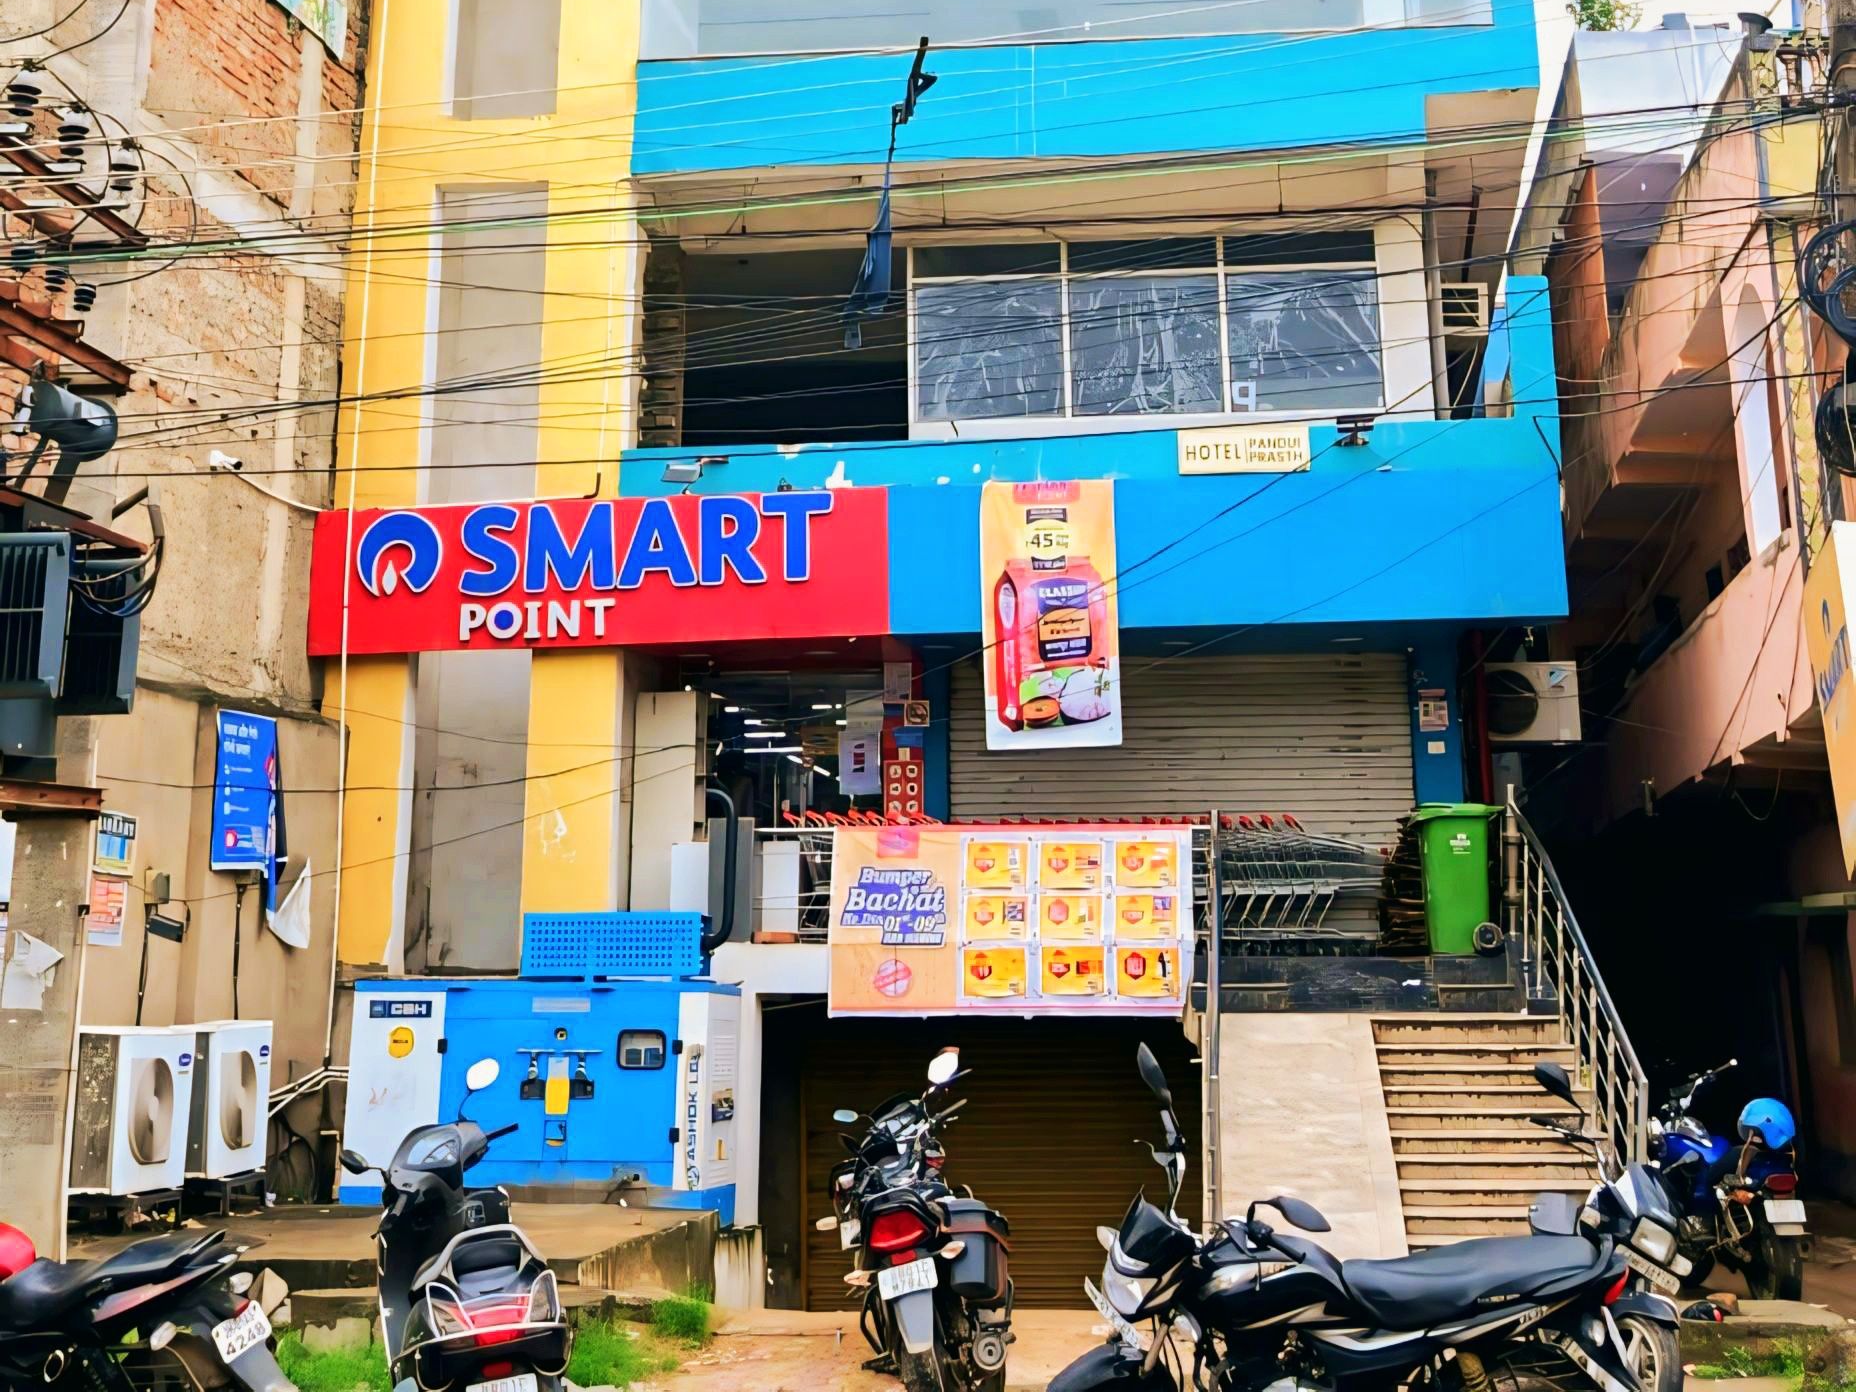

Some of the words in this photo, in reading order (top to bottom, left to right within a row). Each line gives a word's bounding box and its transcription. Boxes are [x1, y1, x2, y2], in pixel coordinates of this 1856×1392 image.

[1186, 443, 1241, 461] HOTEL
[1249, 451, 1302, 462] PRASTH
[459, 493, 834, 596] SMART
[459, 599, 616, 641] POINT
[860, 867, 931, 887] Bumper
[845, 887, 944, 911] Bachat
